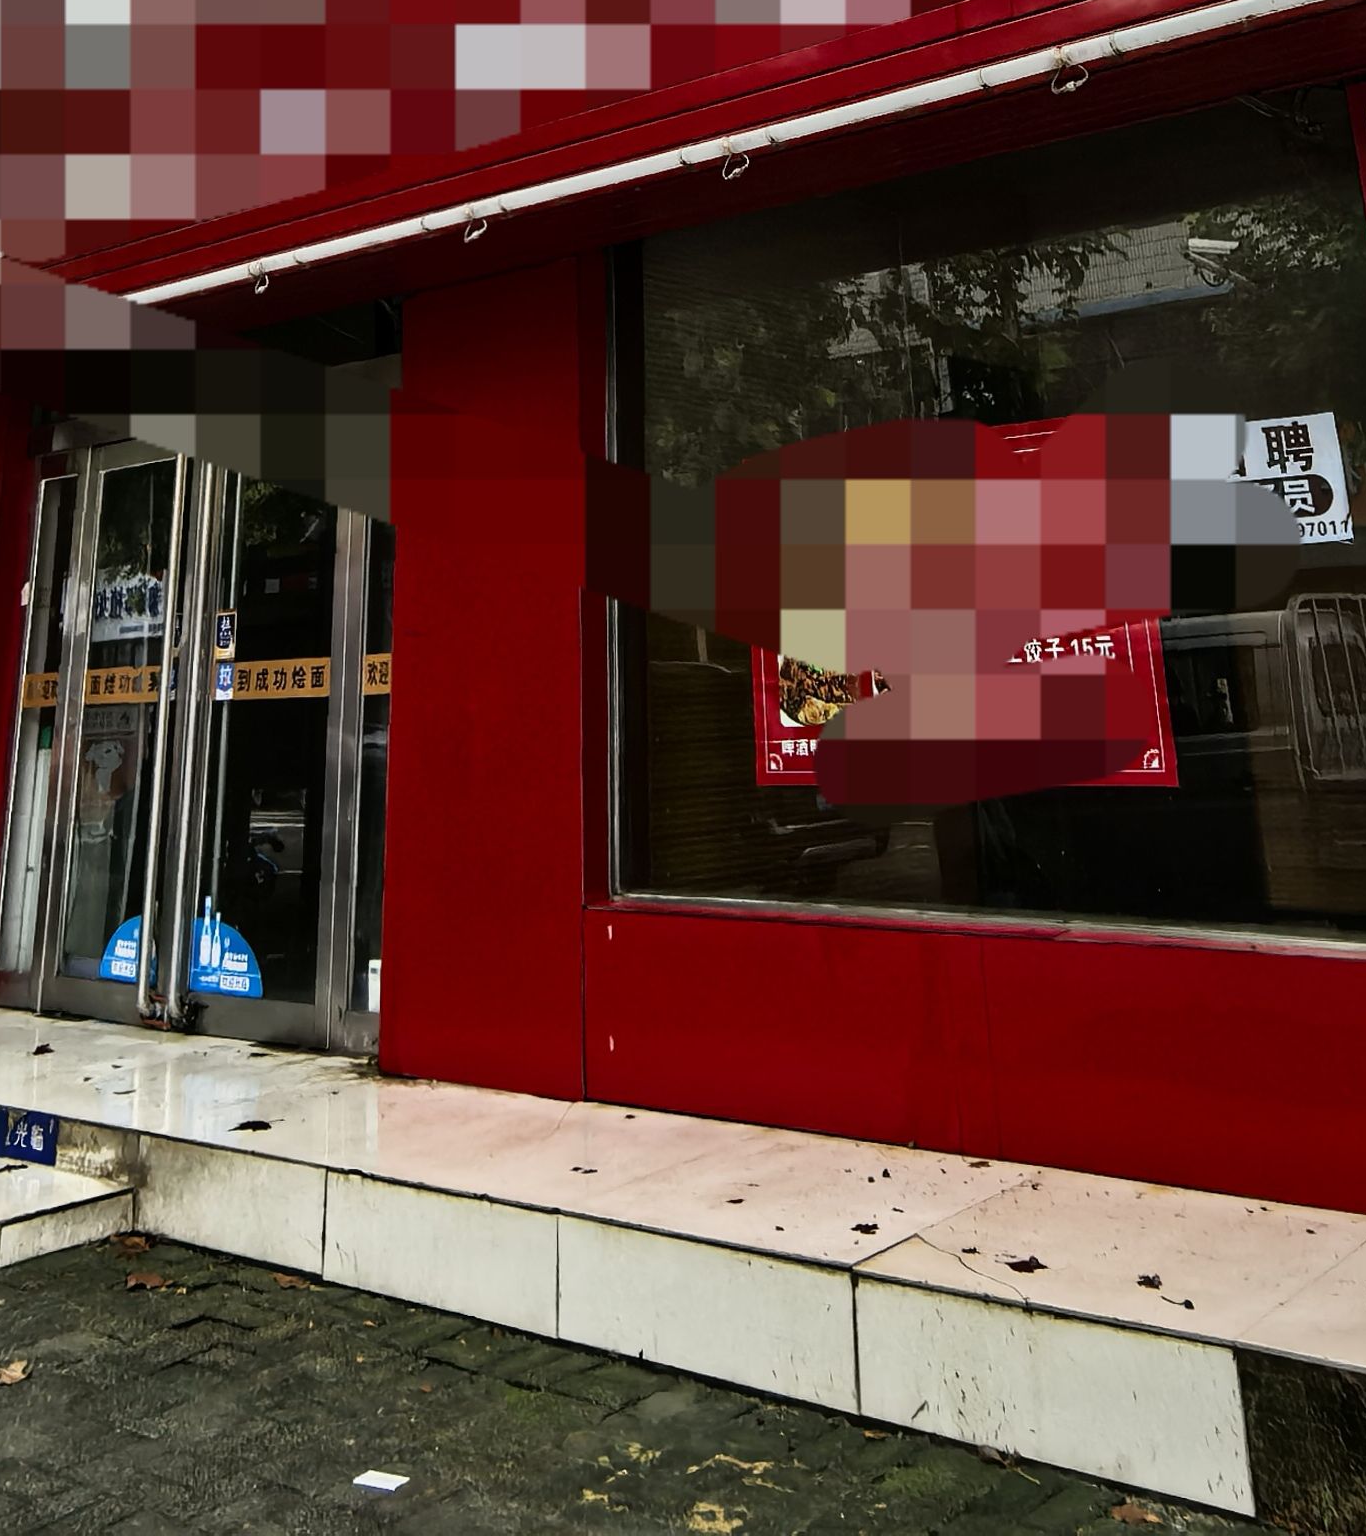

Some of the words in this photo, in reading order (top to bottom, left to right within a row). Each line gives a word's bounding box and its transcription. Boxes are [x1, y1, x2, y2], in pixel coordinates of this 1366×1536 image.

[237, 664, 326, 692] 到成功烩面
[367, 661, 389, 686] 欢迎
